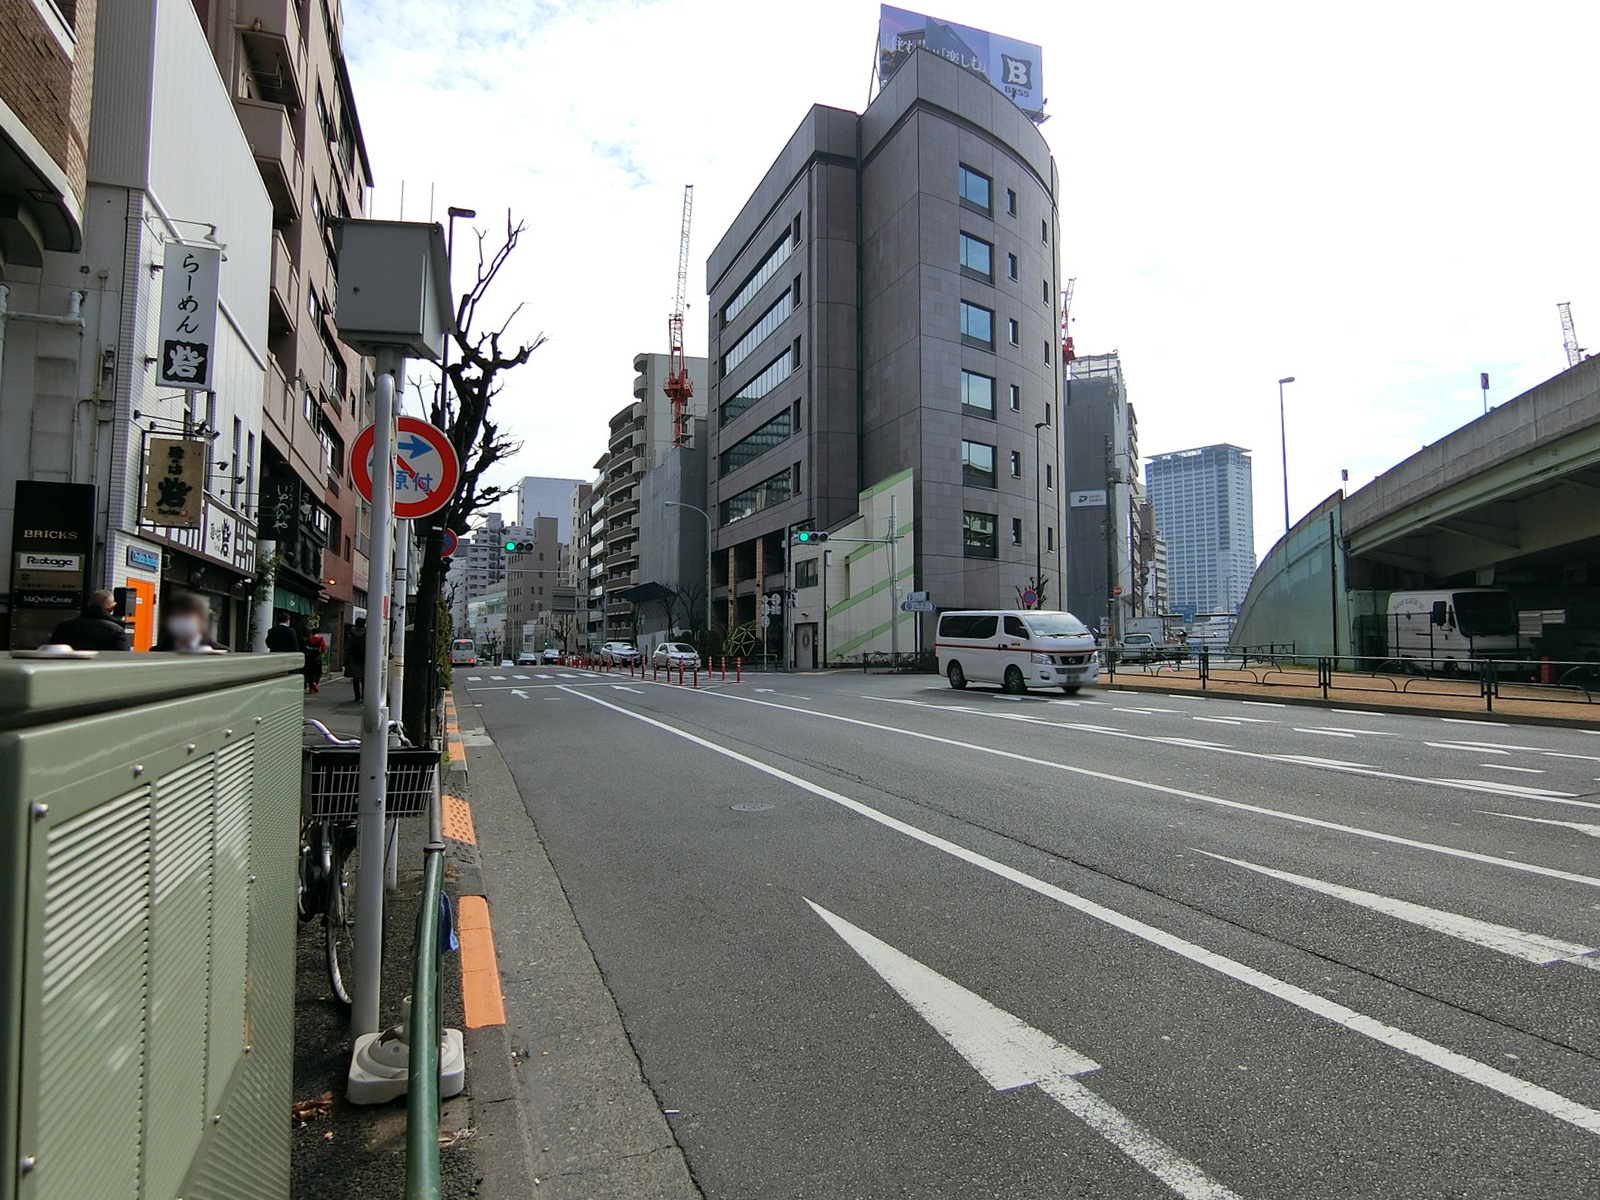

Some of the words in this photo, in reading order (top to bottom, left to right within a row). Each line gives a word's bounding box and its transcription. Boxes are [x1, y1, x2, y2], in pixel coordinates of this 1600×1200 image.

[176, 253, 200, 335] らーめん
[396, 469, 433, 492] 原付
[23, 529, 78, 540] BRICKS
